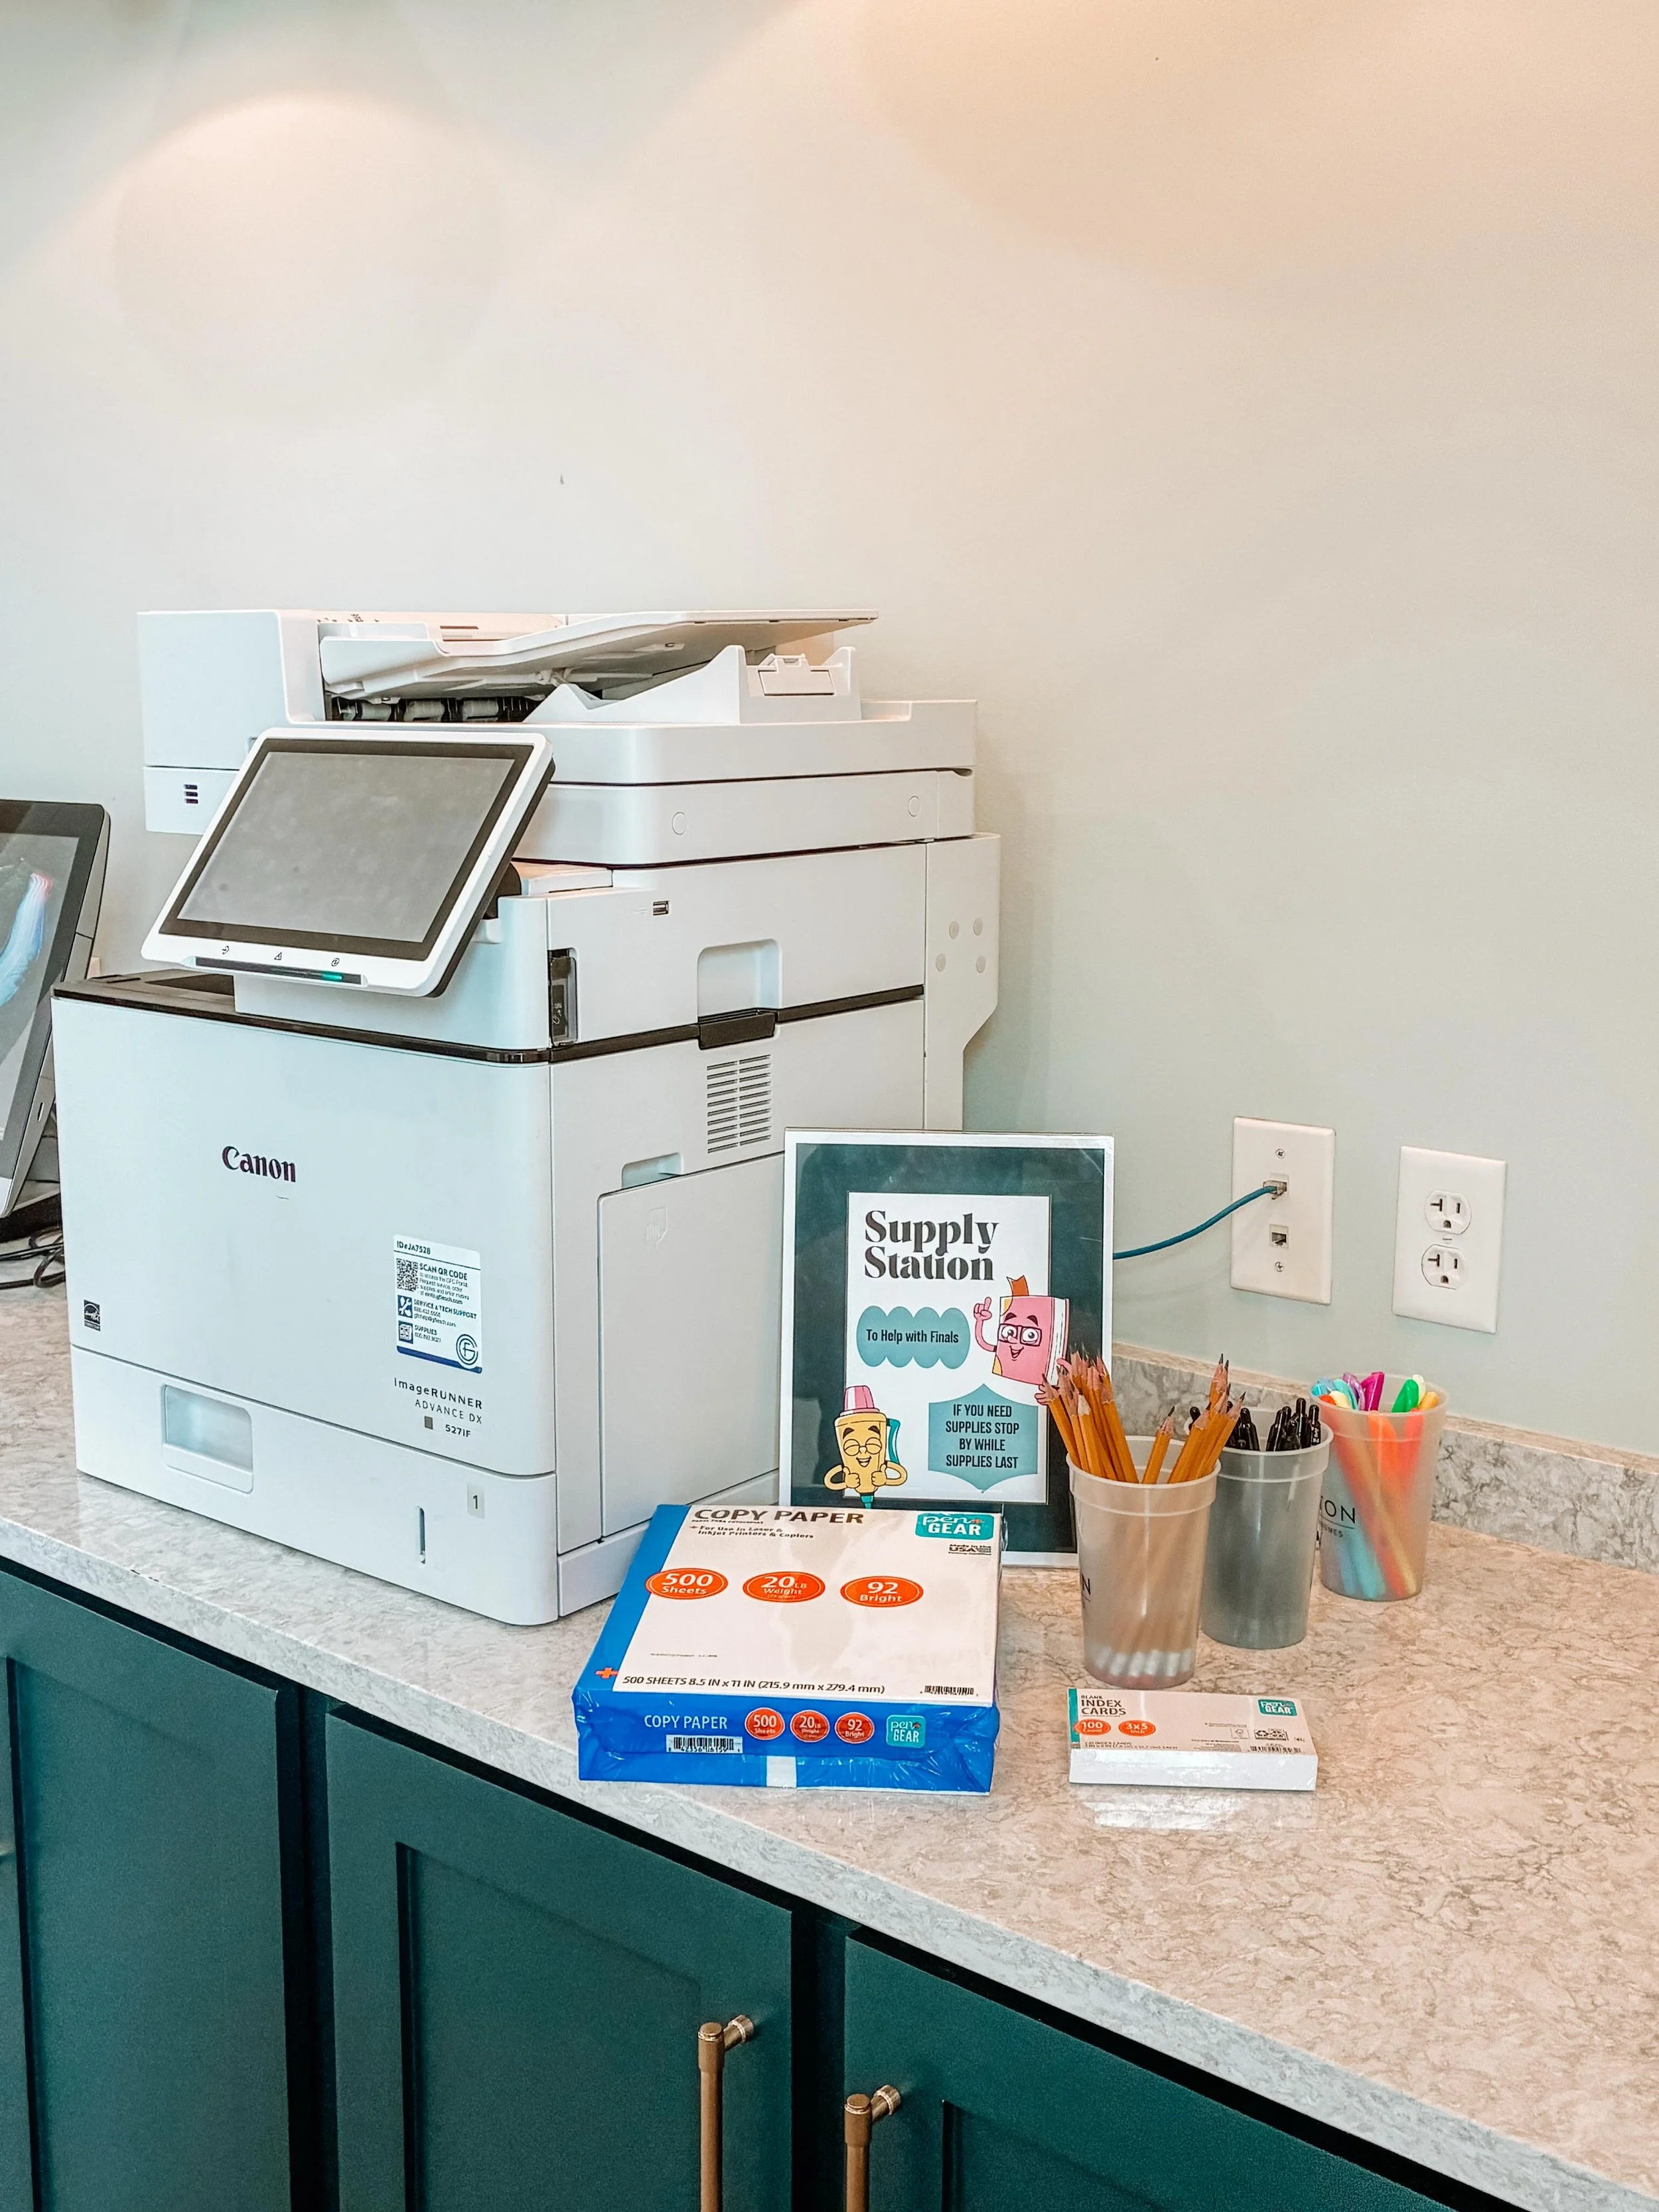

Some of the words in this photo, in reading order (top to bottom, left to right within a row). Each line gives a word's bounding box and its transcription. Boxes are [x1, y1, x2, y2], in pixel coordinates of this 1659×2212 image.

[222, 1146, 296, 1183] Canon
[865, 1210, 999, 1254] Supply
[864, 1246, 994, 1281] Station
[419, 1263, 437, 1274] SCAN
[438, 1267, 448, 1276] QR
[449, 1270, 468, 1281] CODE
[866, 1329, 878, 1342] To
[881, 1329, 903, 1345] Help
[906, 1329, 928, 1343] with
[930, 1330, 959, 1344] Finals
[415, 1399, 465, 1420] ADVANCE
[469, 1413, 482, 1424] DX
[953, 1404, 962, 1416] IF
[964, 1404, 985, 1417] YOU
[987, 1404, 1012, 1418] NEED
[945, 1420, 992, 1434] SUPPLIES
[994, 1422, 1019, 1435] STOP
[959, 1438, 972, 1451] BY
[974, 1438, 1005, 1451] WHILE
[946, 1455, 992, 1468] SUPPLIES
[995, 1456, 1019, 1469] LAST
[472, 1495, 478, 1510] 1
[694, 1509, 768, 1520] COPY
[774, 1511, 864, 1524] PAPER
[928, 1522, 982, 1536] GEAR
[661, 1573, 713, 1587] 500
[661, 1586, 707, 1595] Sheets
[867, 1582, 899, 1594] 92
[859, 1594, 902, 1603] Bright
[622, 1676, 644, 1684] 500
[646, 1676, 687, 1686] SHEETS
[689, 1678, 706, 1686] 8.5
[708, 1678, 720, 1688] IN
[743, 1680, 756, 1689] IN
[758, 1680, 790, 1690] (215.9
[858, 1684, 885, 1694] mm)
[1081, 1707, 1127, 1716] CARDS
[1265, 1704, 1292, 1715] GEAR
[644, 1714, 680, 1729] COPY
[684, 1716, 727, 1730] PAPER
[753, 1714, 777, 1728] 500
[847, 1719, 863, 1732] 92
[891, 1720, 915, 1733] pen
[1081, 1721, 1104, 1730] 100
[893, 1728, 920, 1743] GEAR
